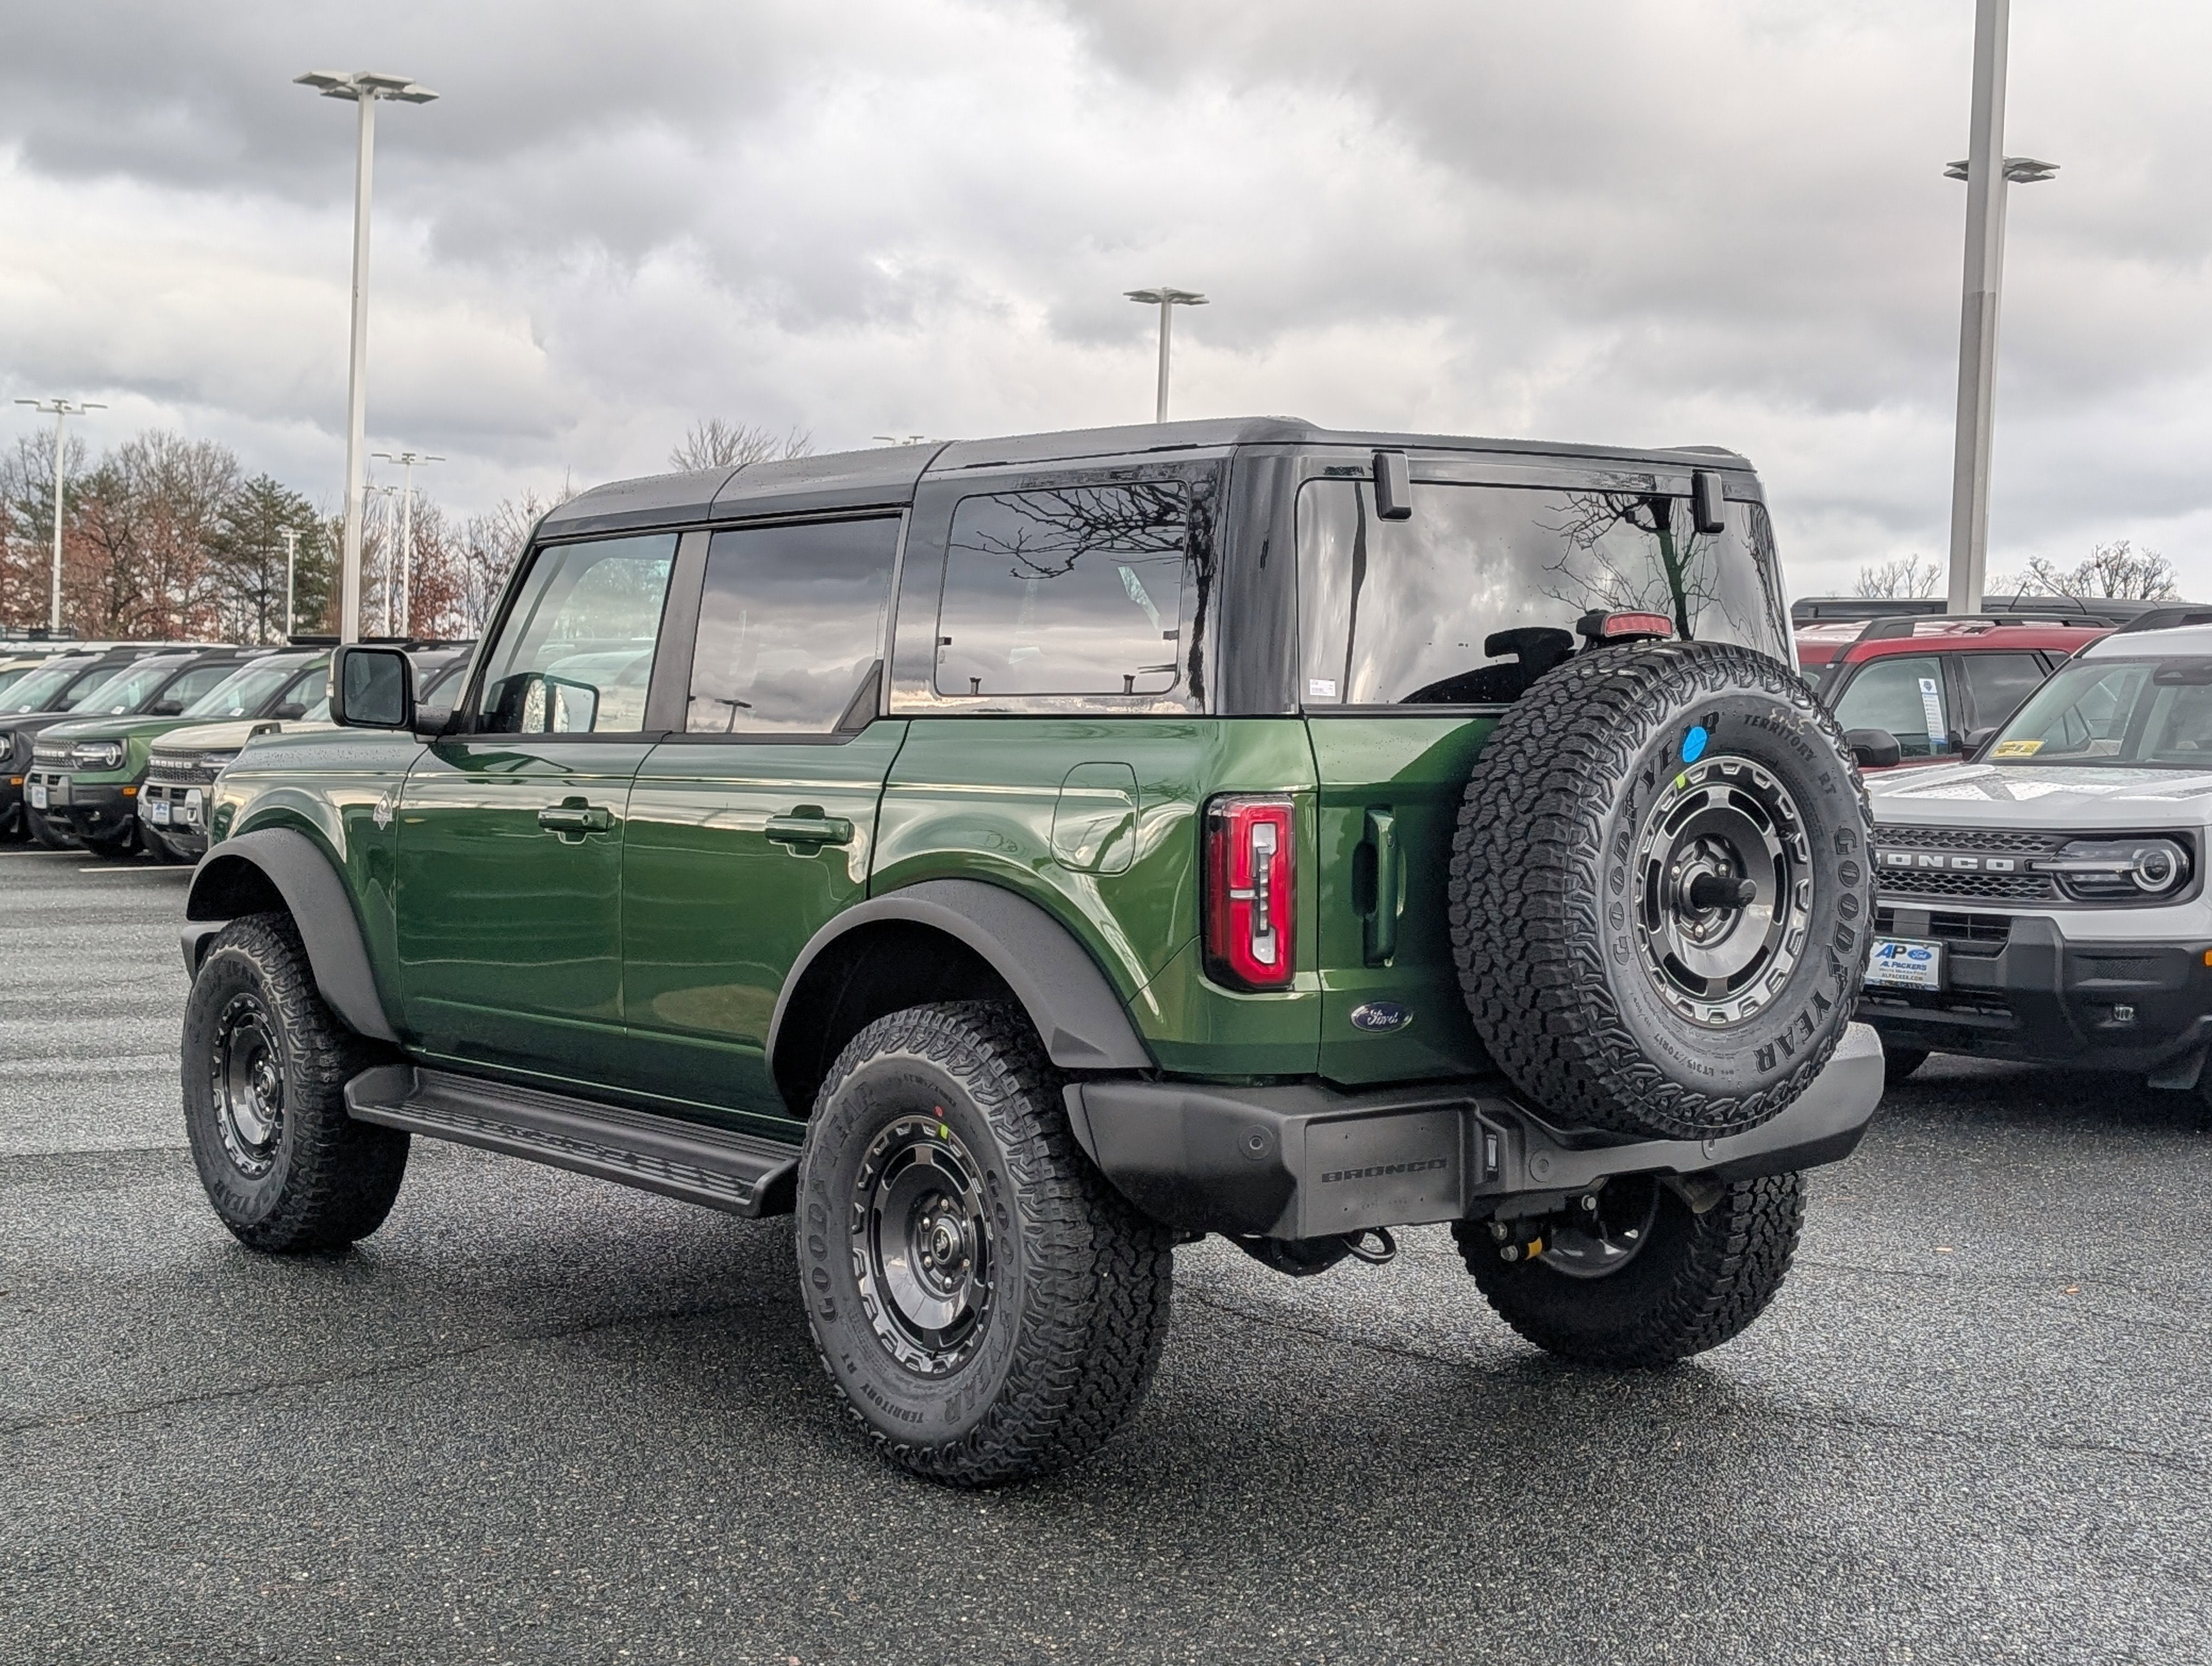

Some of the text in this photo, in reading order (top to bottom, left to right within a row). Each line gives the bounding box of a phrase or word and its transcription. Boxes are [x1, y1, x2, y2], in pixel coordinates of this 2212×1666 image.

[1744, 714, 1818, 761] TERRITORY
[1818, 771, 1837, 795] RT
[1609, 711, 1720, 966] GOODYER
[1875, 853, 2014, 871] ONCO
[1753, 826, 1860, 1074] GOODYEAR
[1875, 944, 1907, 959] AP
[1891, 962, 1927, 971] PACKERS
[1367, 1009, 1399, 1026] Ford
[1654, 1033, 1714, 1077] LT315/70R17
[1321, 1158, 1447, 1183] BRONCO
[860, 1383, 924, 1424] TERRITORY
